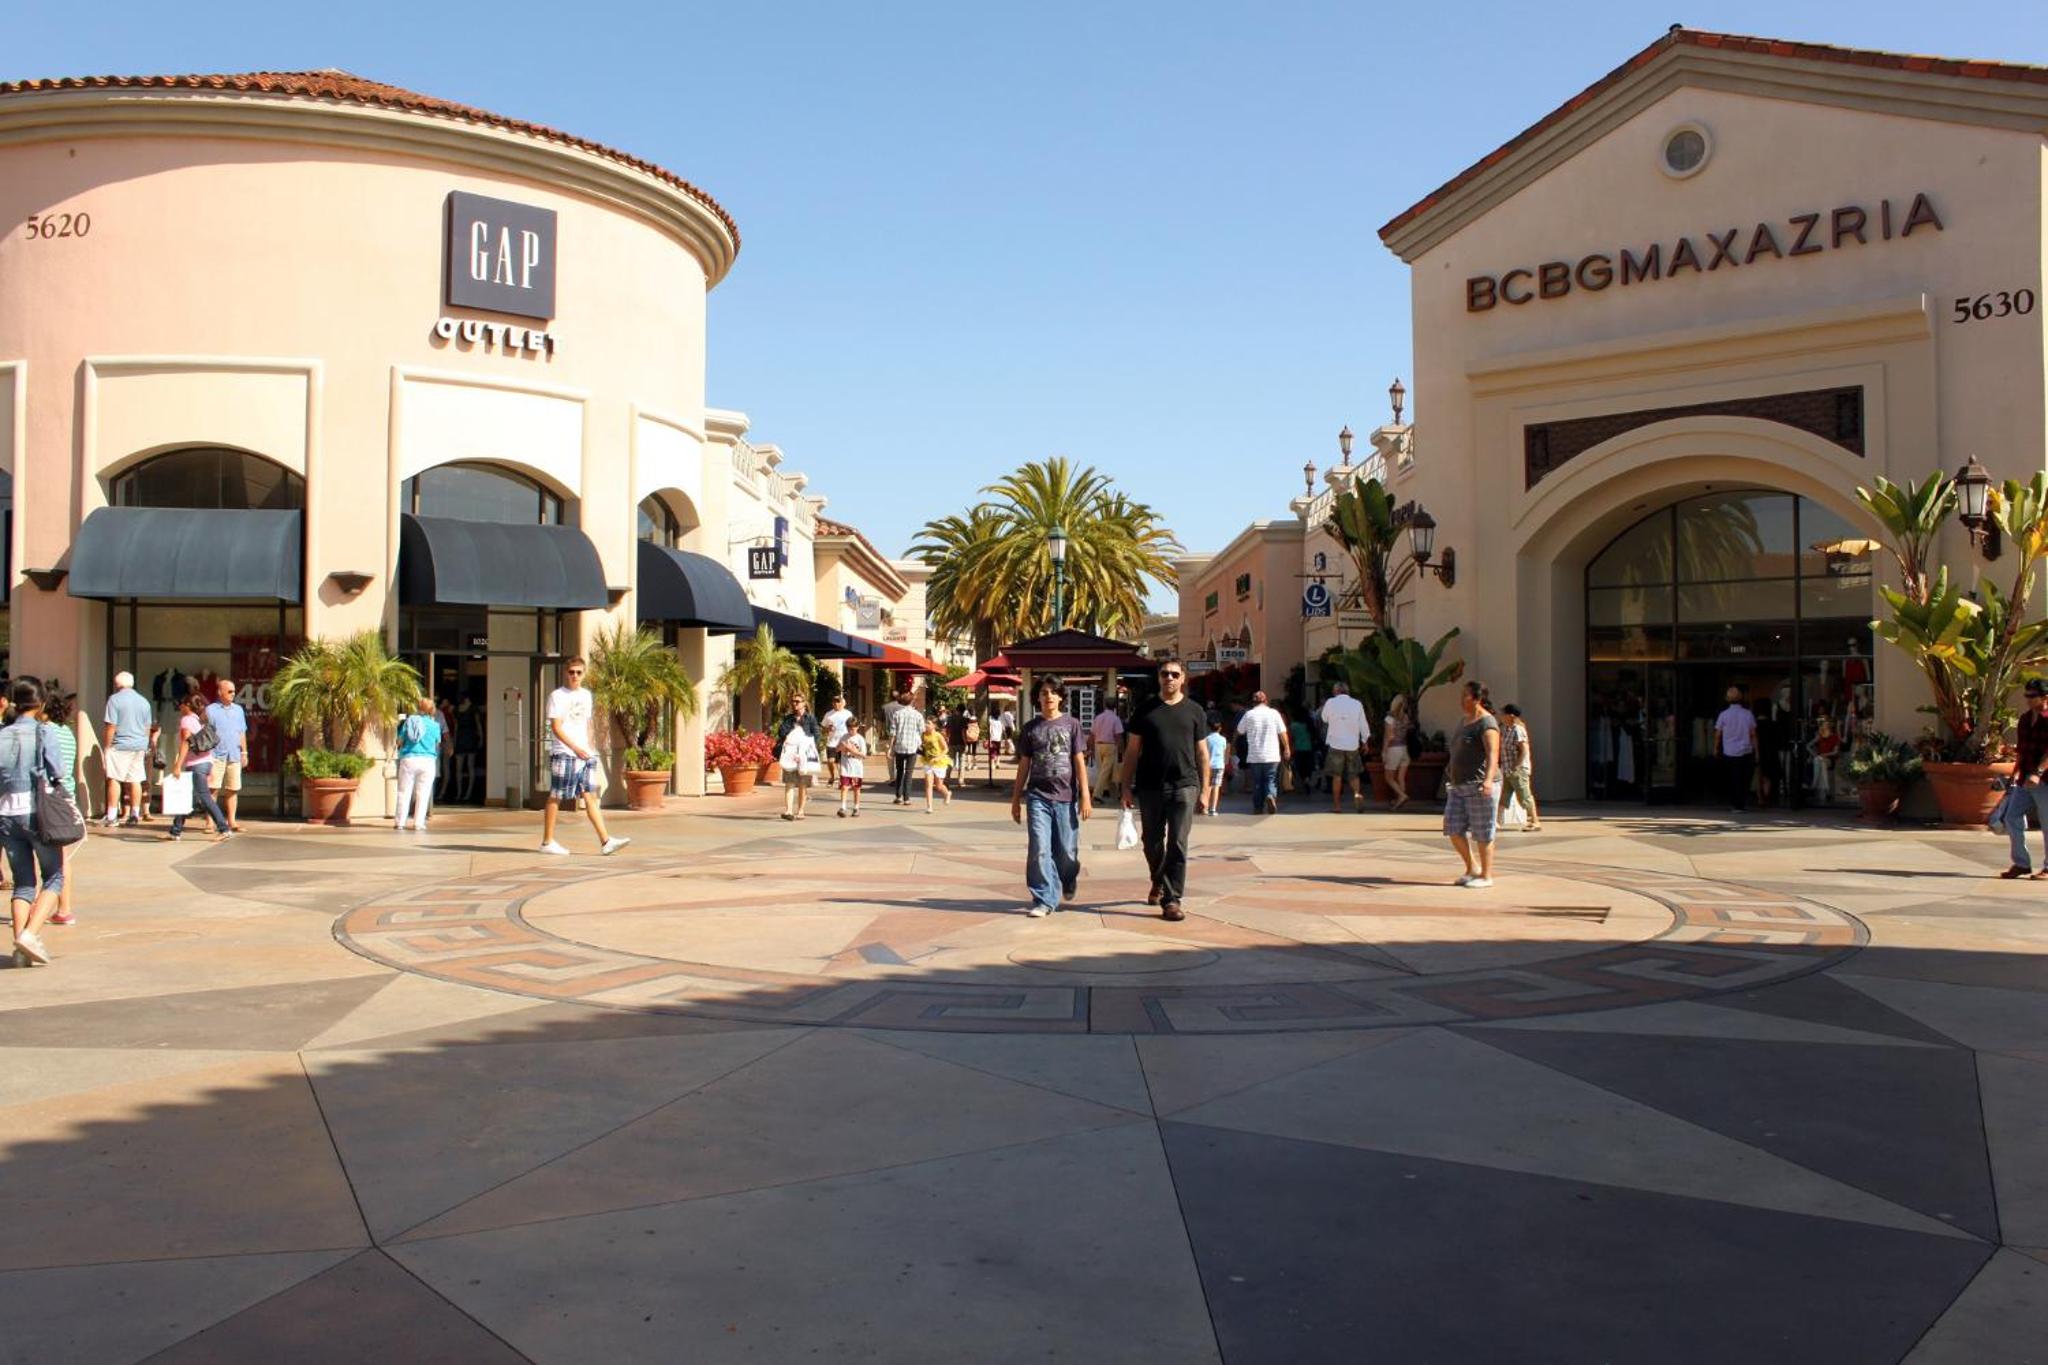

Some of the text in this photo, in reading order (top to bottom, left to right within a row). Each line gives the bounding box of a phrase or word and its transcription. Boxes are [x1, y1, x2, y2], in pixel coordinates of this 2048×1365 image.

[25, 212, 91, 240] 5620
[470, 220, 540, 289] GAP
[1465, 191, 1945, 313] BCBGMAXAZRIA
[1952, 287, 2035, 324] 5630
[434, 316, 559, 357] OUTLET
[752, 552, 776, 570] GAP
